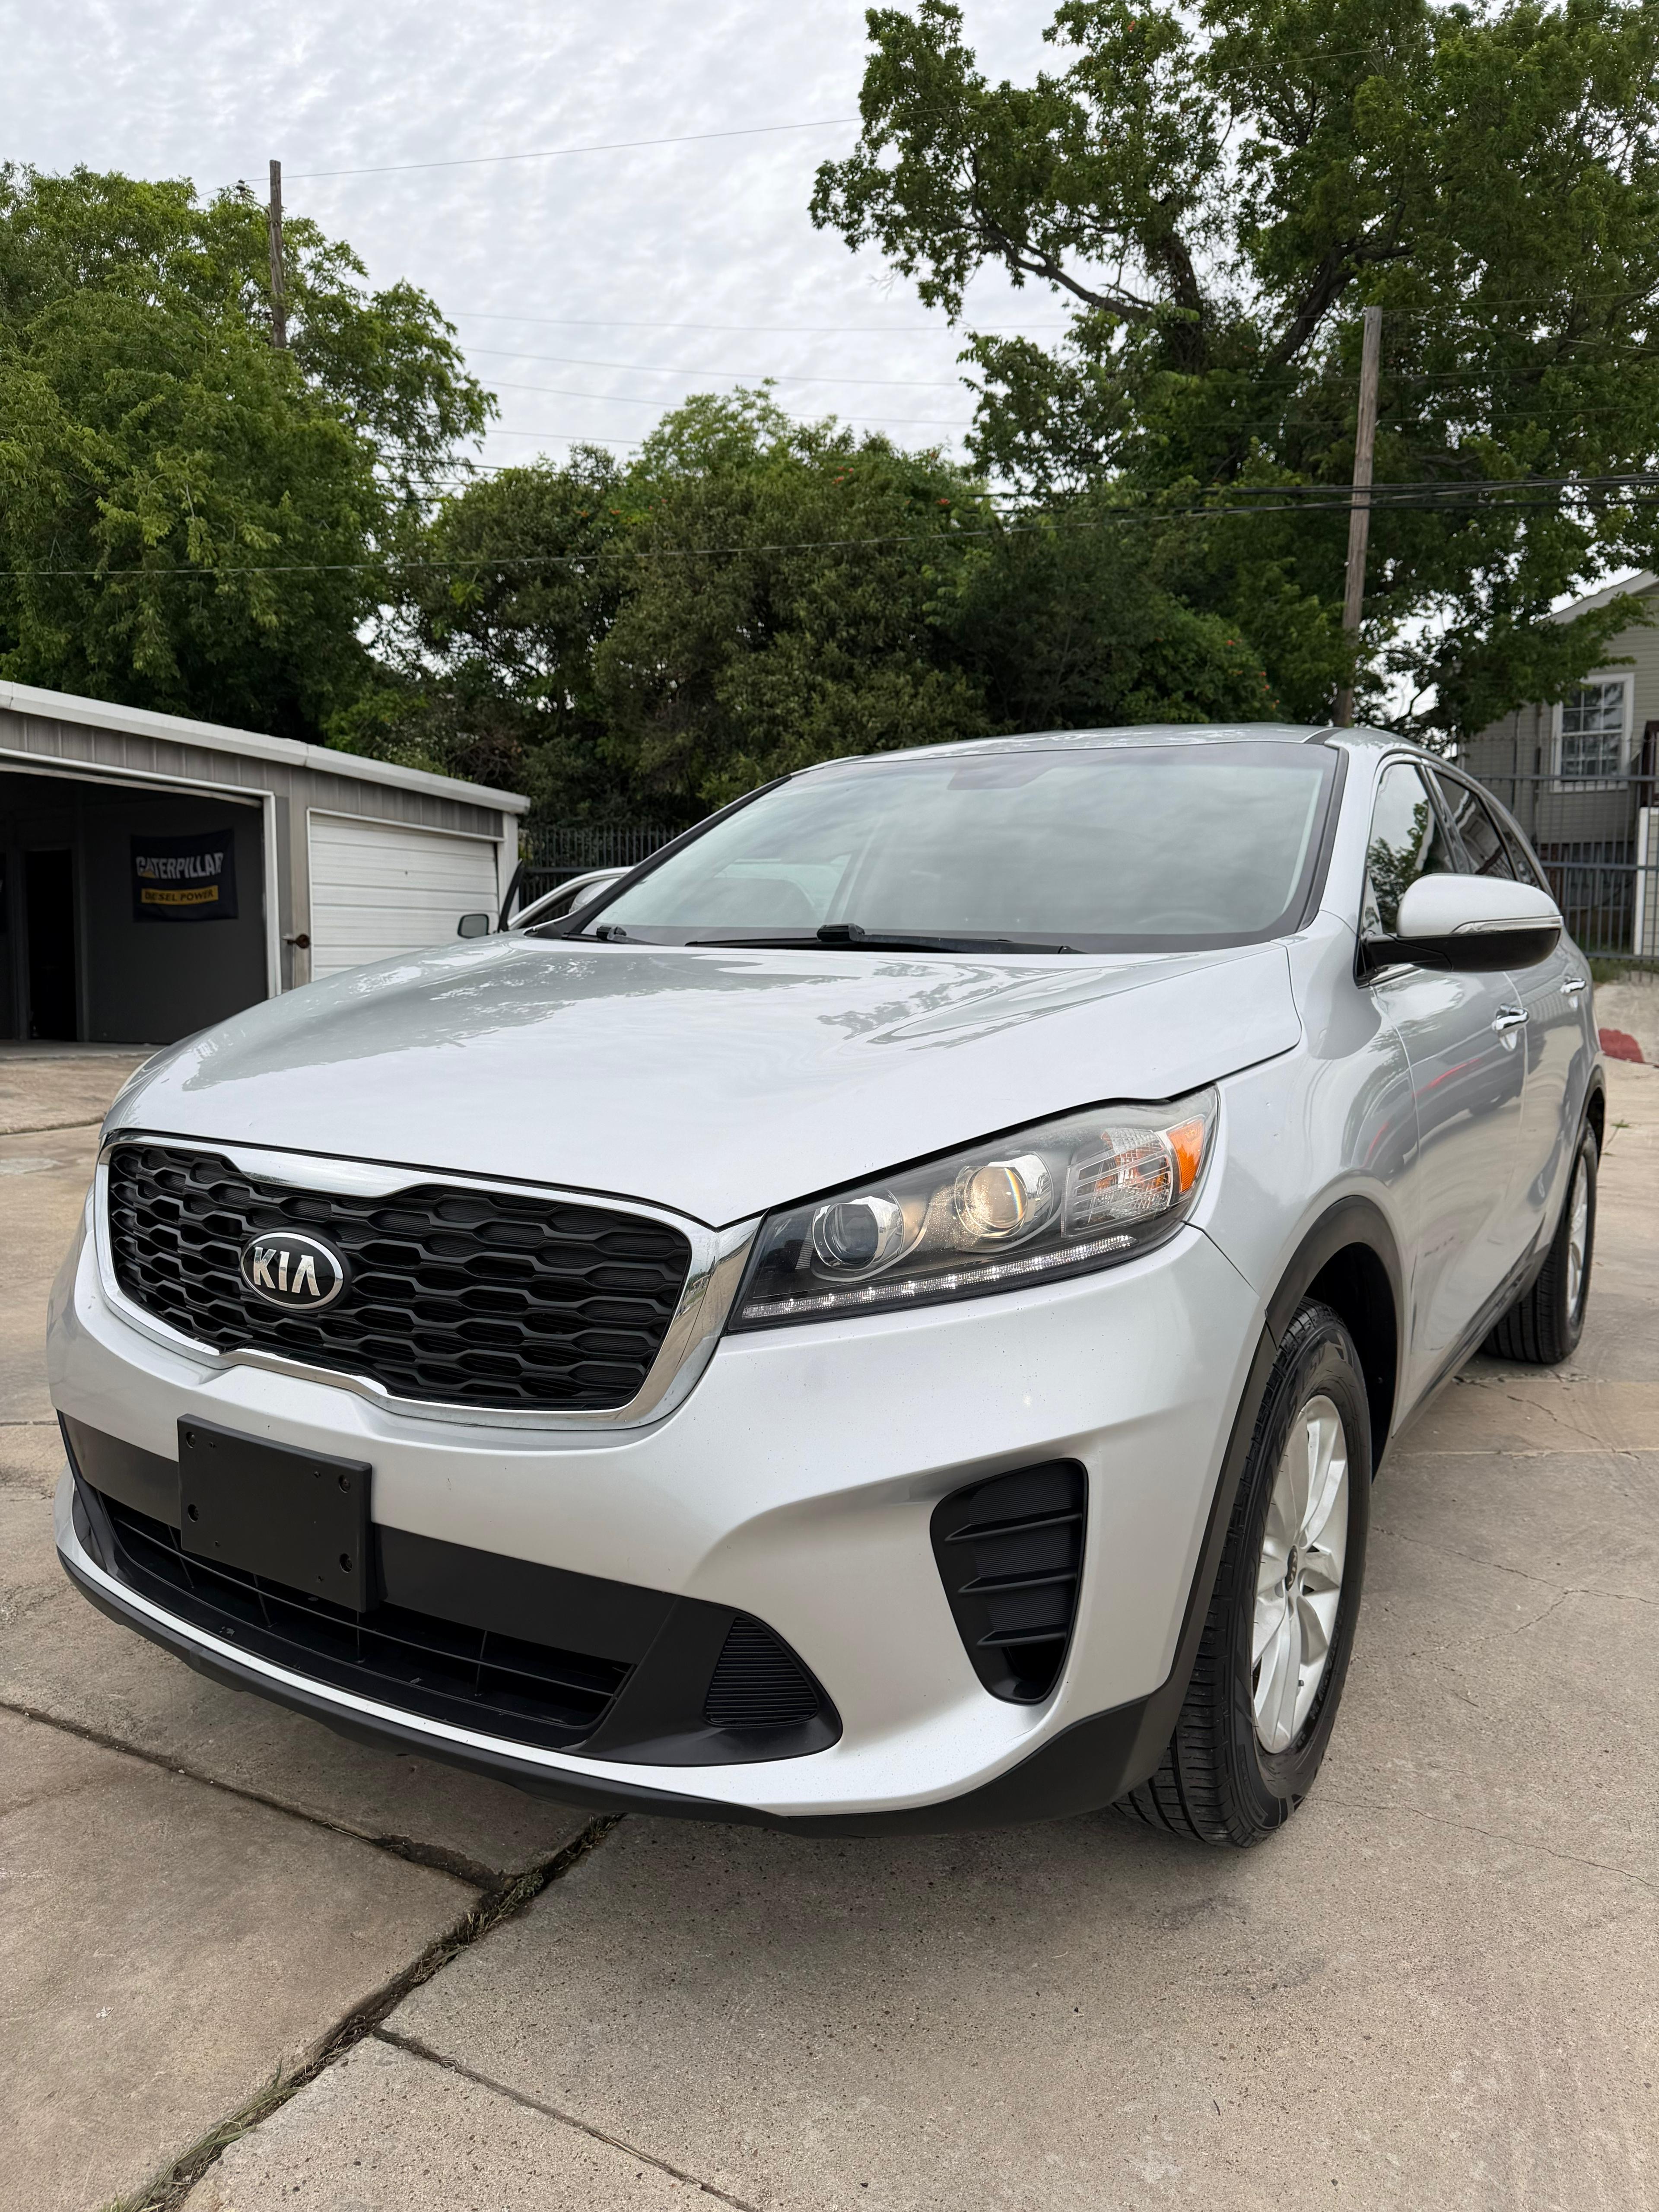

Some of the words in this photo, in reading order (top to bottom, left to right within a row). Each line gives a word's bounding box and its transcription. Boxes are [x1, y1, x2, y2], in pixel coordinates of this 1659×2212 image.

[136, 852, 224, 879] CATERPILLAR
[180, 889, 213, 901] POWER
[253, 1246, 321, 1296] KIA
[1288, 1551, 1297, 1585] KIA
